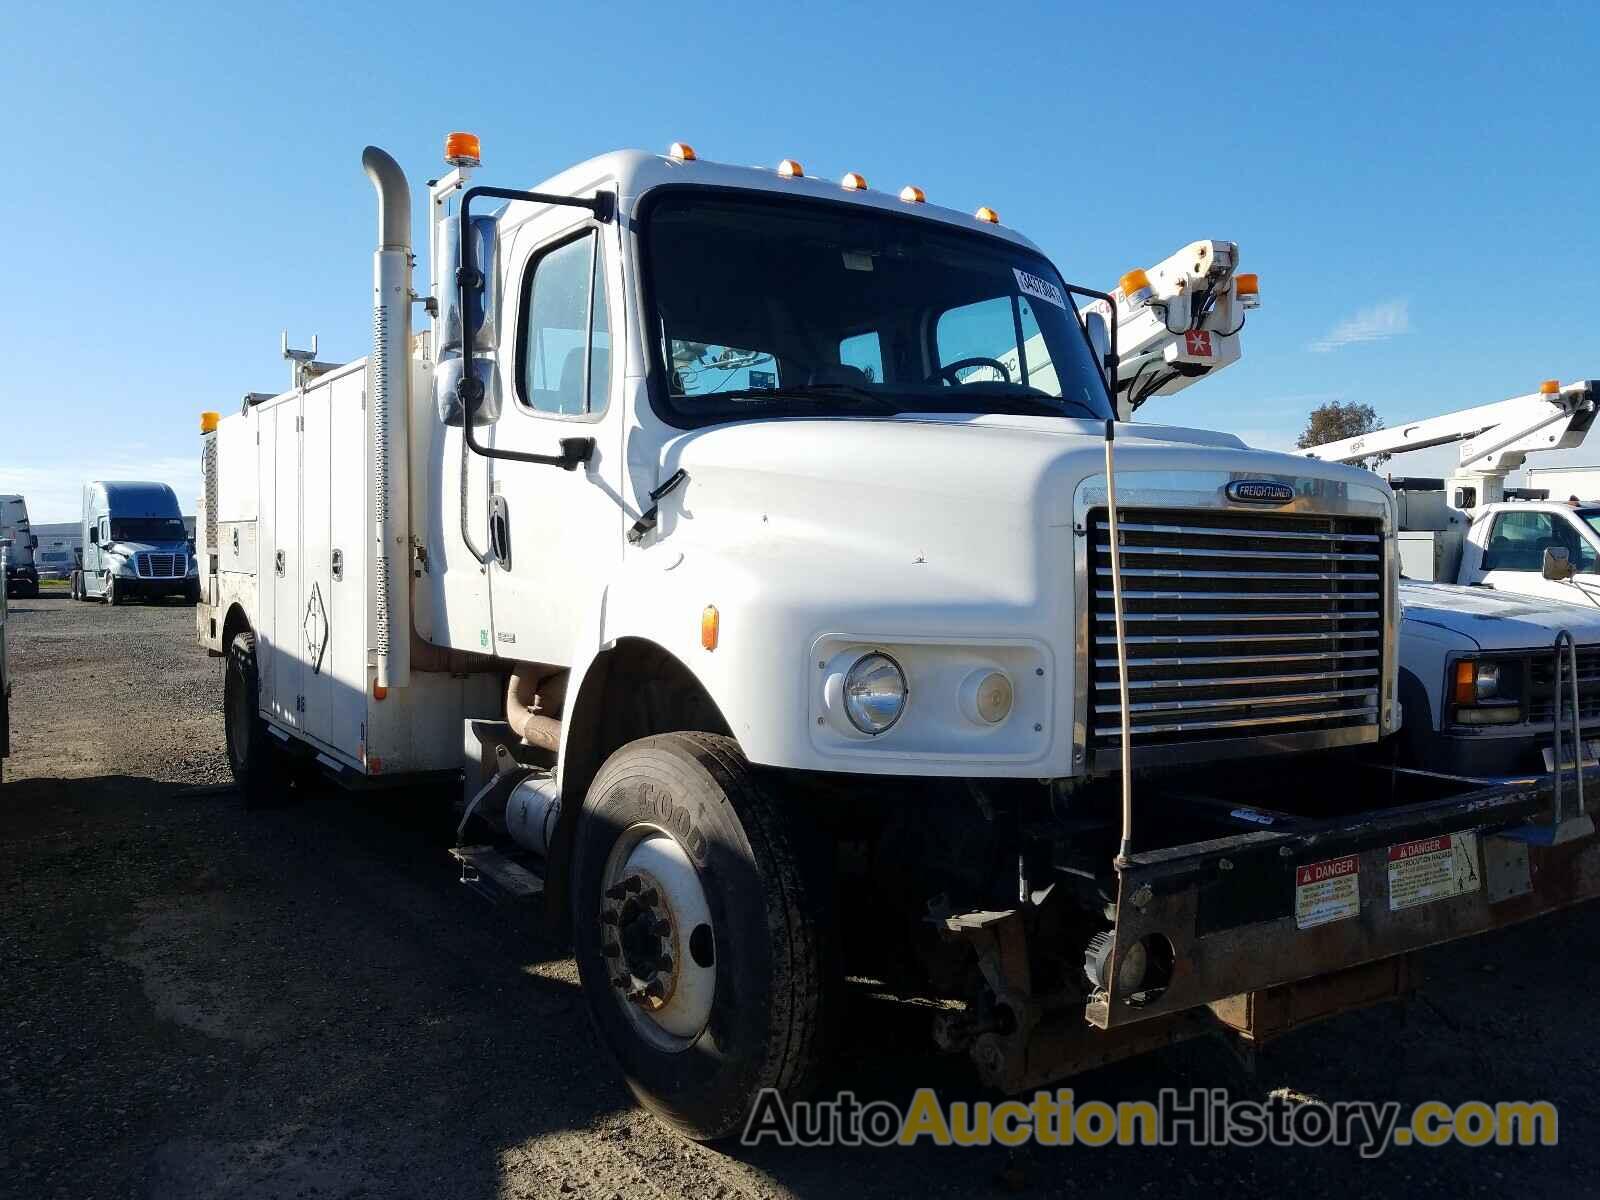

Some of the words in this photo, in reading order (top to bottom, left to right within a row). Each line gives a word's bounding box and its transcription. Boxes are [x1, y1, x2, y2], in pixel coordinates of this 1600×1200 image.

[1239, 485, 1291, 498] FREIGHTLINER
[1407, 839, 1441, 857] DANGER
[1315, 859, 1353, 881] DANGER
